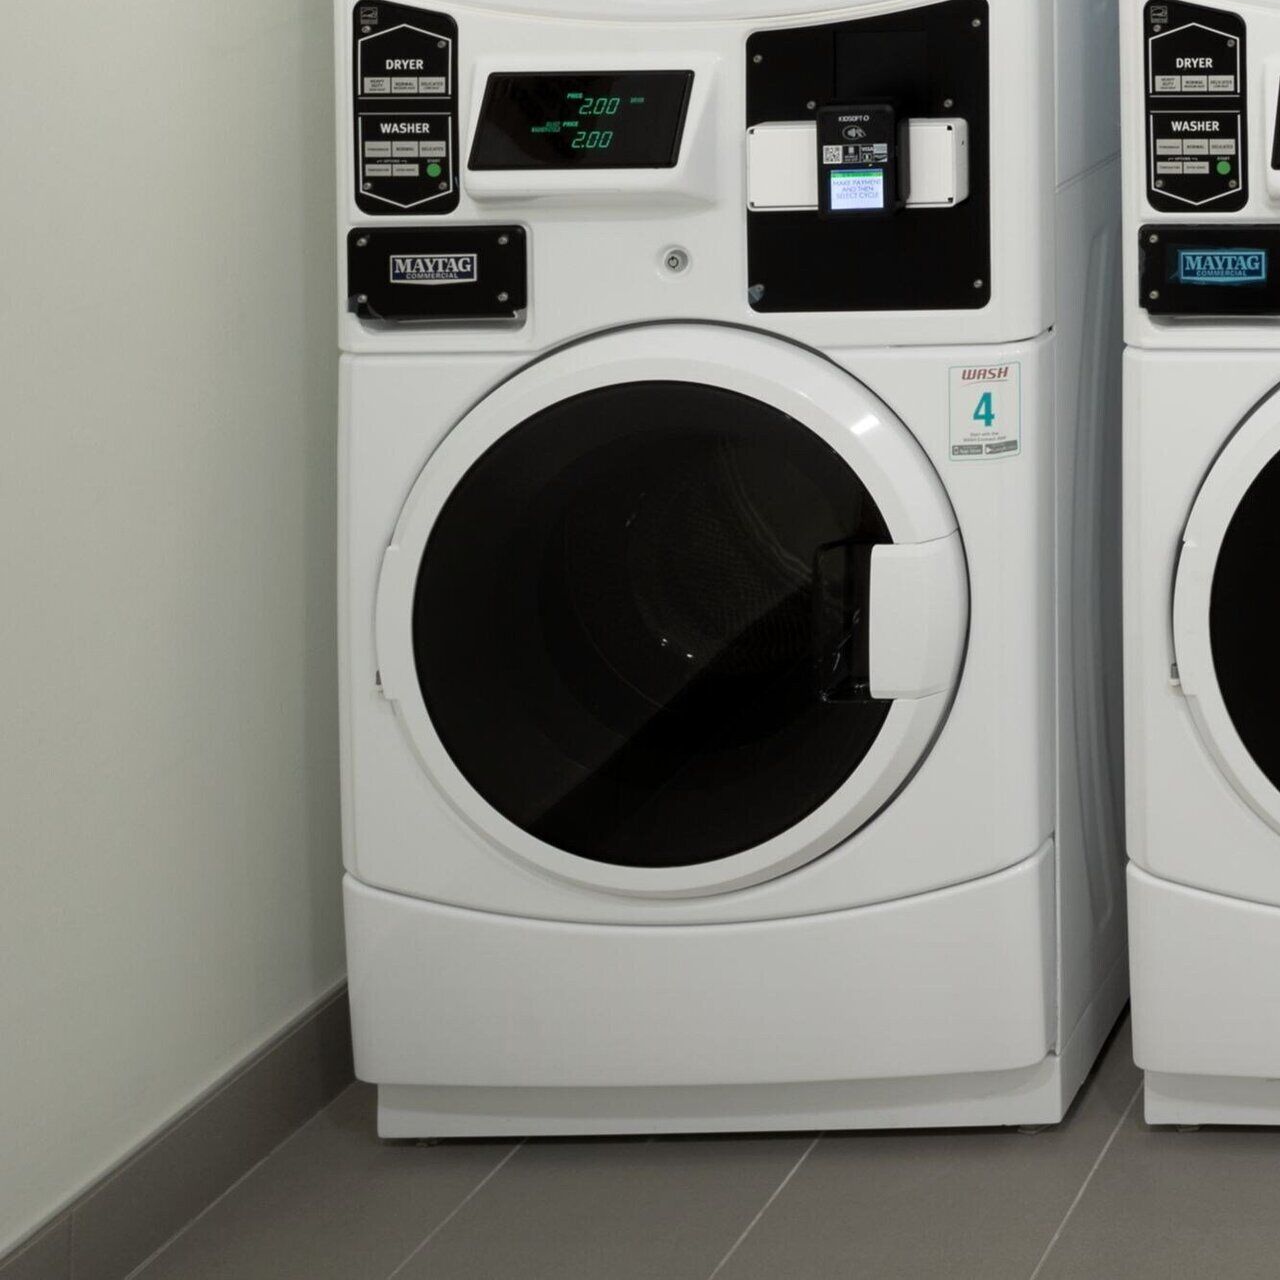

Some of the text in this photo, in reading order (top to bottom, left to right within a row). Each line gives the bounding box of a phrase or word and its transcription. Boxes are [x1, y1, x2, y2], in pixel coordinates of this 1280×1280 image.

[385, 58, 424, 70] DRYER
[1175, 57, 1213, 69] DRYER
[578, 97, 620, 115] 2.00
[380, 122, 430, 134] WASHER
[1171, 120, 1220, 132] WASHER
[571, 131, 613, 148] 2.00
[394, 257, 471, 273] MAYTAG
[1185, 255, 1260, 270] MAYTAG
[405, 272, 459, 280] COMMERCIAL
[961, 367, 1009, 380] WASH
[973, 391, 995, 427] 4
